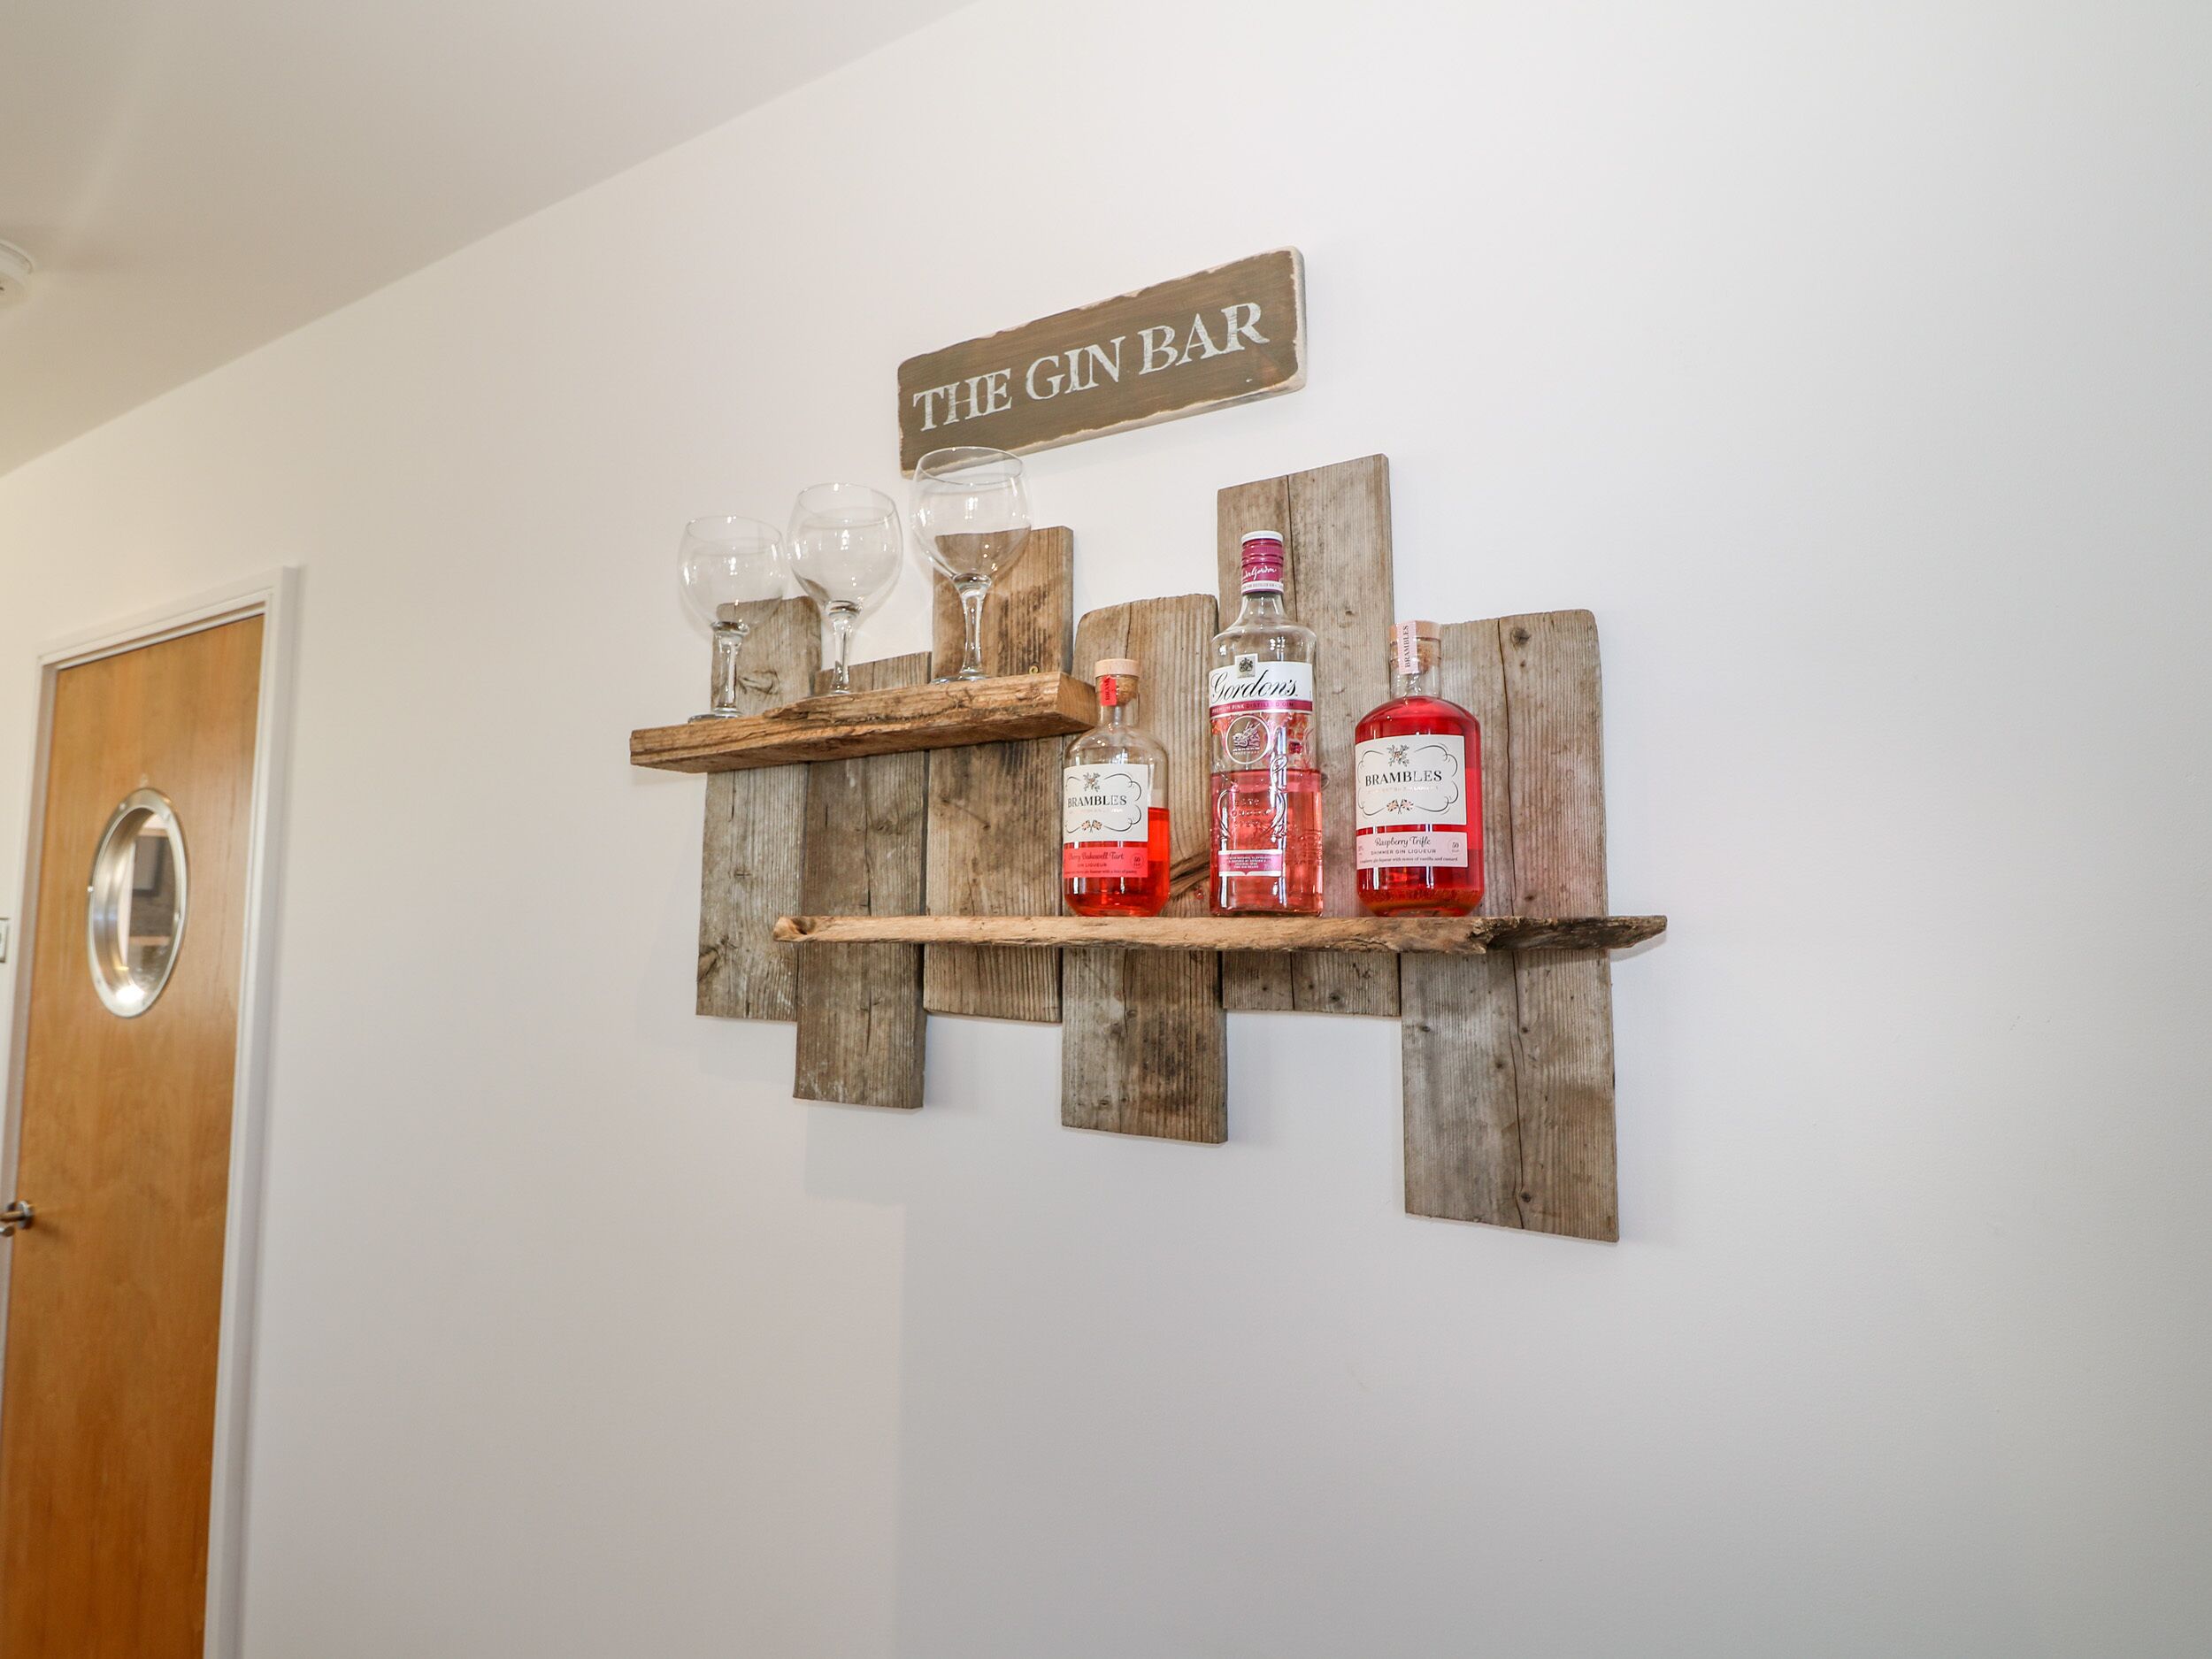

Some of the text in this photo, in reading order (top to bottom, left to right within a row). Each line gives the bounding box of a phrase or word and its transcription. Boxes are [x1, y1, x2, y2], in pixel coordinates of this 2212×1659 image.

[913, 302, 1270, 432] THE GIN BAR
[1402, 625, 1411, 668] BRAMBLES
[1210, 670, 1298, 703] Gordon's
[1365, 770, 1442, 787] BRAMBLES
[1067, 795, 1127, 808] BRAMBLES
[1375, 836, 1431, 848] Raspberry Trifle
[1081, 851, 1108, 860] Bakewell
[1110, 851, 1124, 860] Tart
